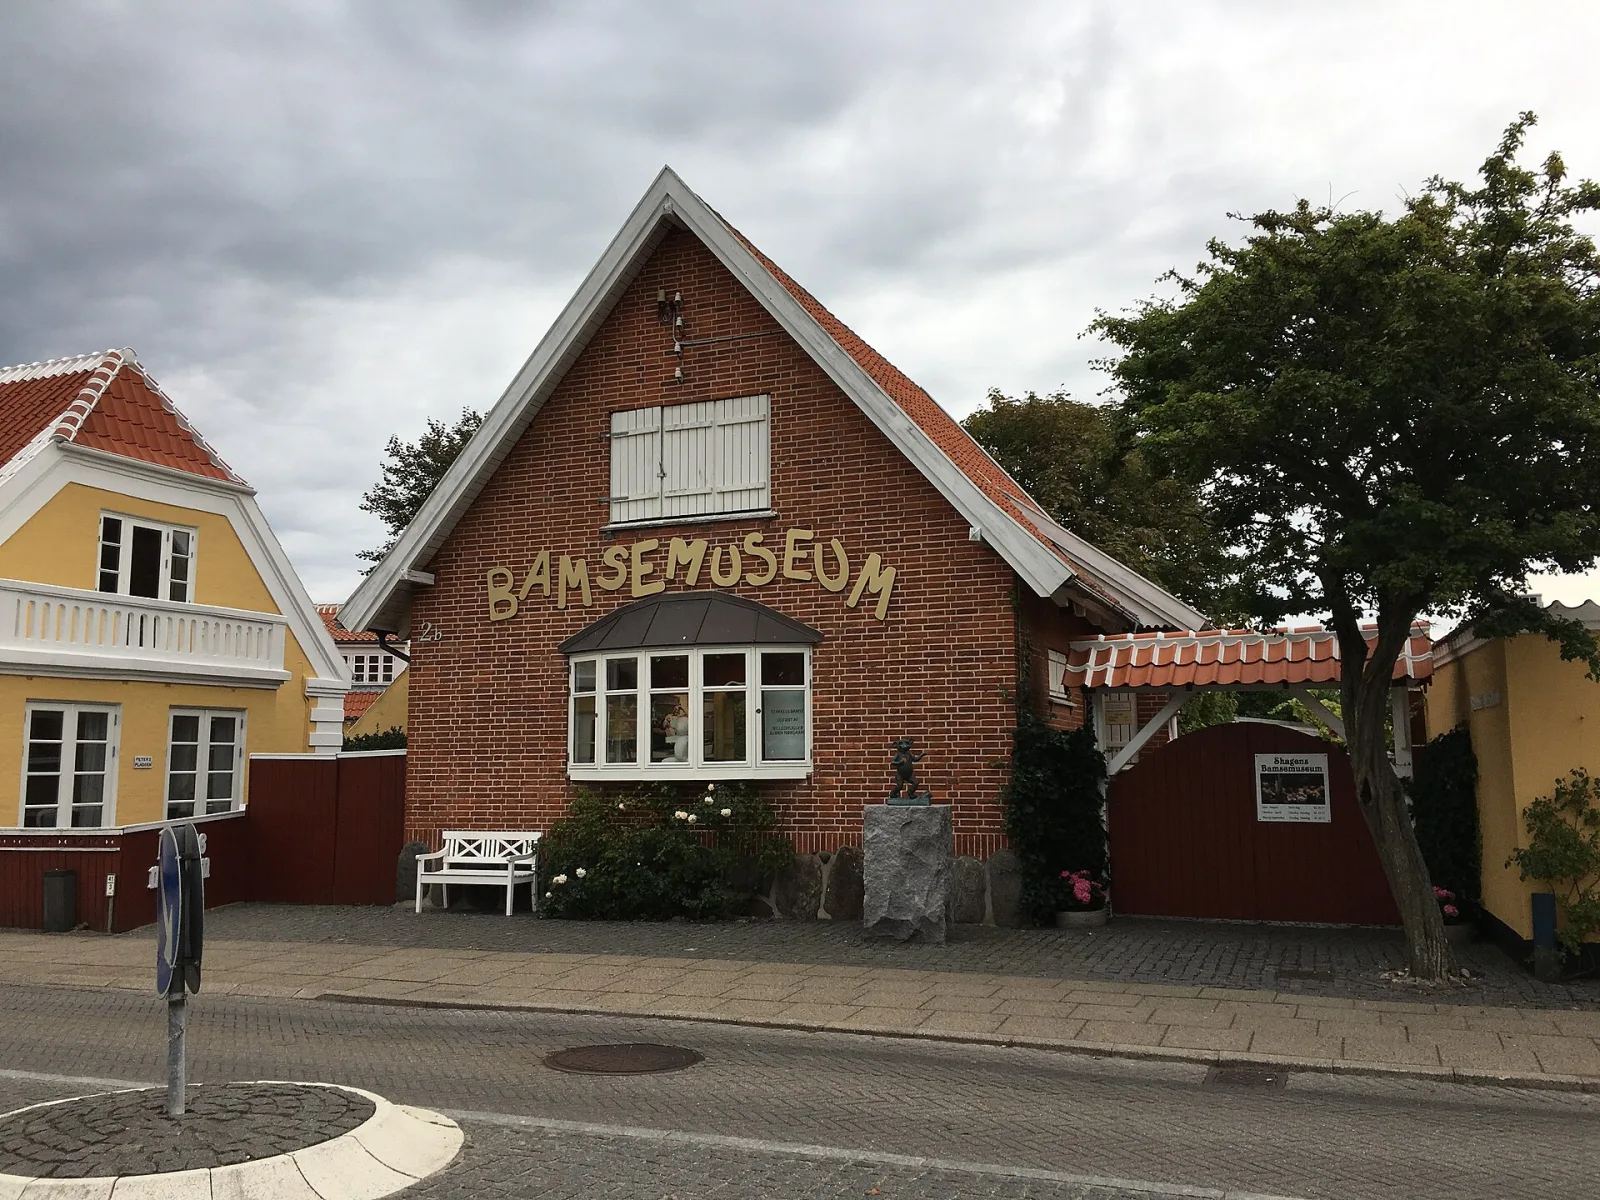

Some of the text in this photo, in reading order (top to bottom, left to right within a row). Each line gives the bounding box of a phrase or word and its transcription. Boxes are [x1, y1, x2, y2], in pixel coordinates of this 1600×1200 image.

[487, 528, 896, 621] BAMSEMUSEUM
[419, 622, 442, 641] 2b
[1261, 764, 1323, 772] Bamsemuseum
